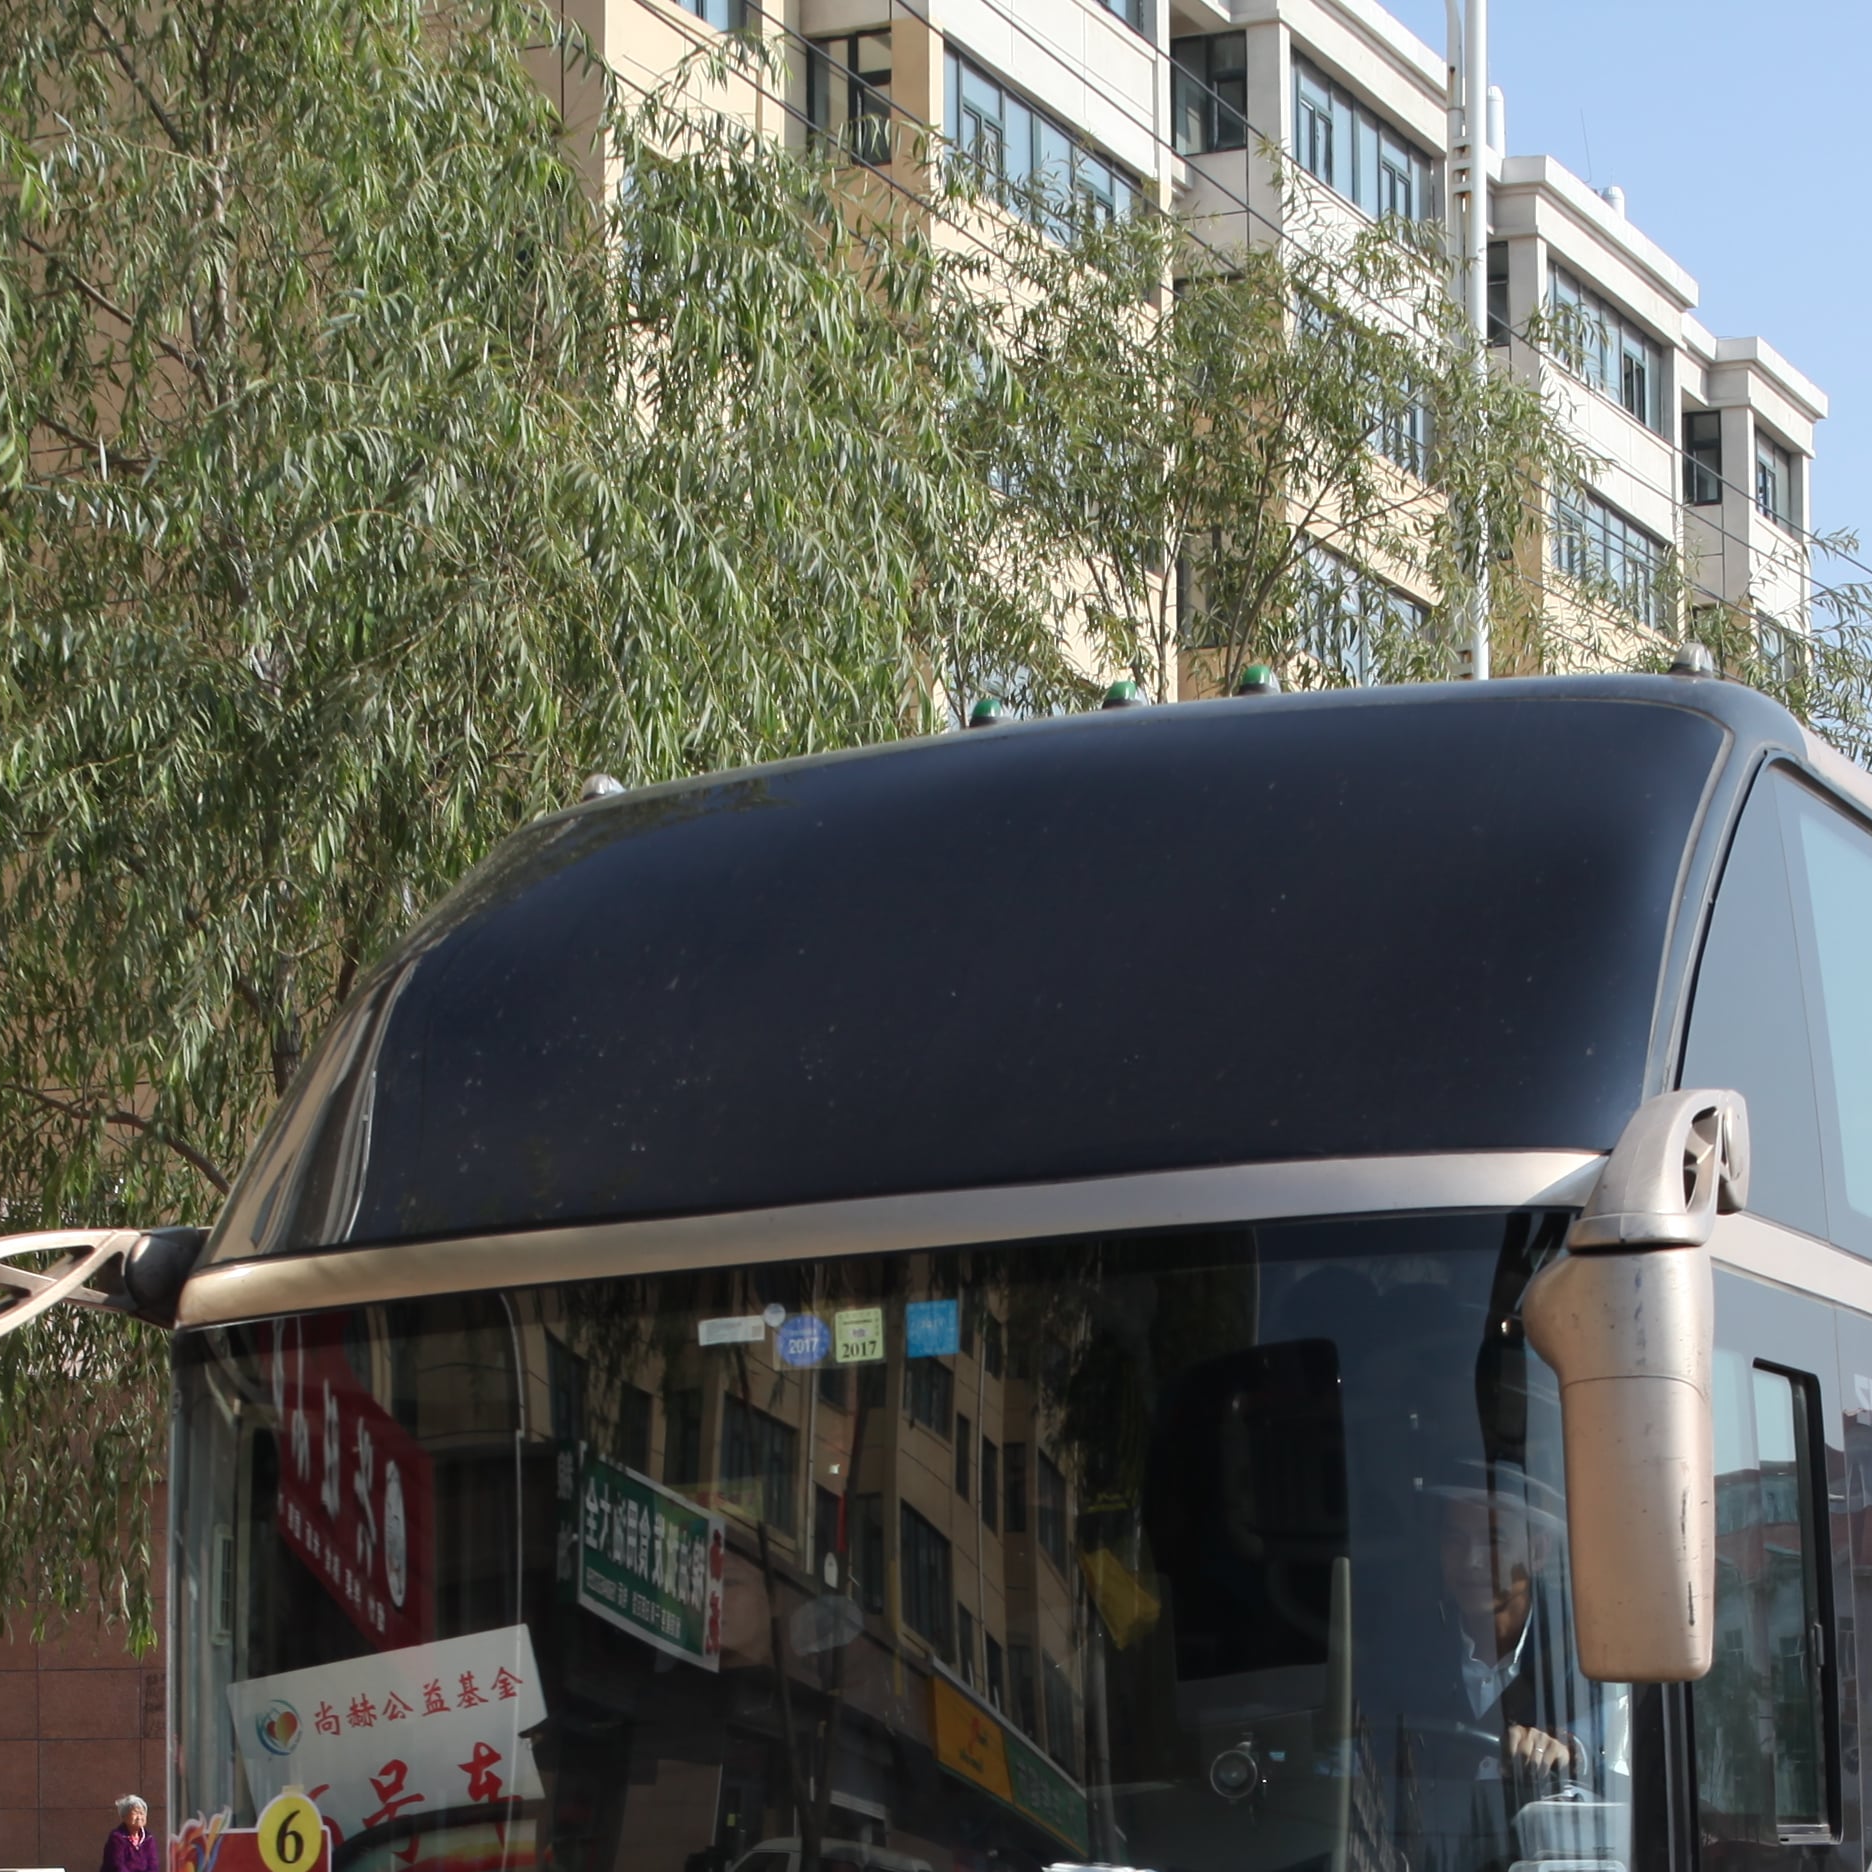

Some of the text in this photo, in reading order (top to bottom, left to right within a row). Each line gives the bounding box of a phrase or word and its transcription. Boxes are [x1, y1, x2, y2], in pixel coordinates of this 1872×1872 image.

[789, 1338, 819, 1354] 2017
[842, 1340, 877, 1359] 2017
[313, 1665, 524, 1738] 尚赫公益基金
[276, 1810, 305, 1864] 6
